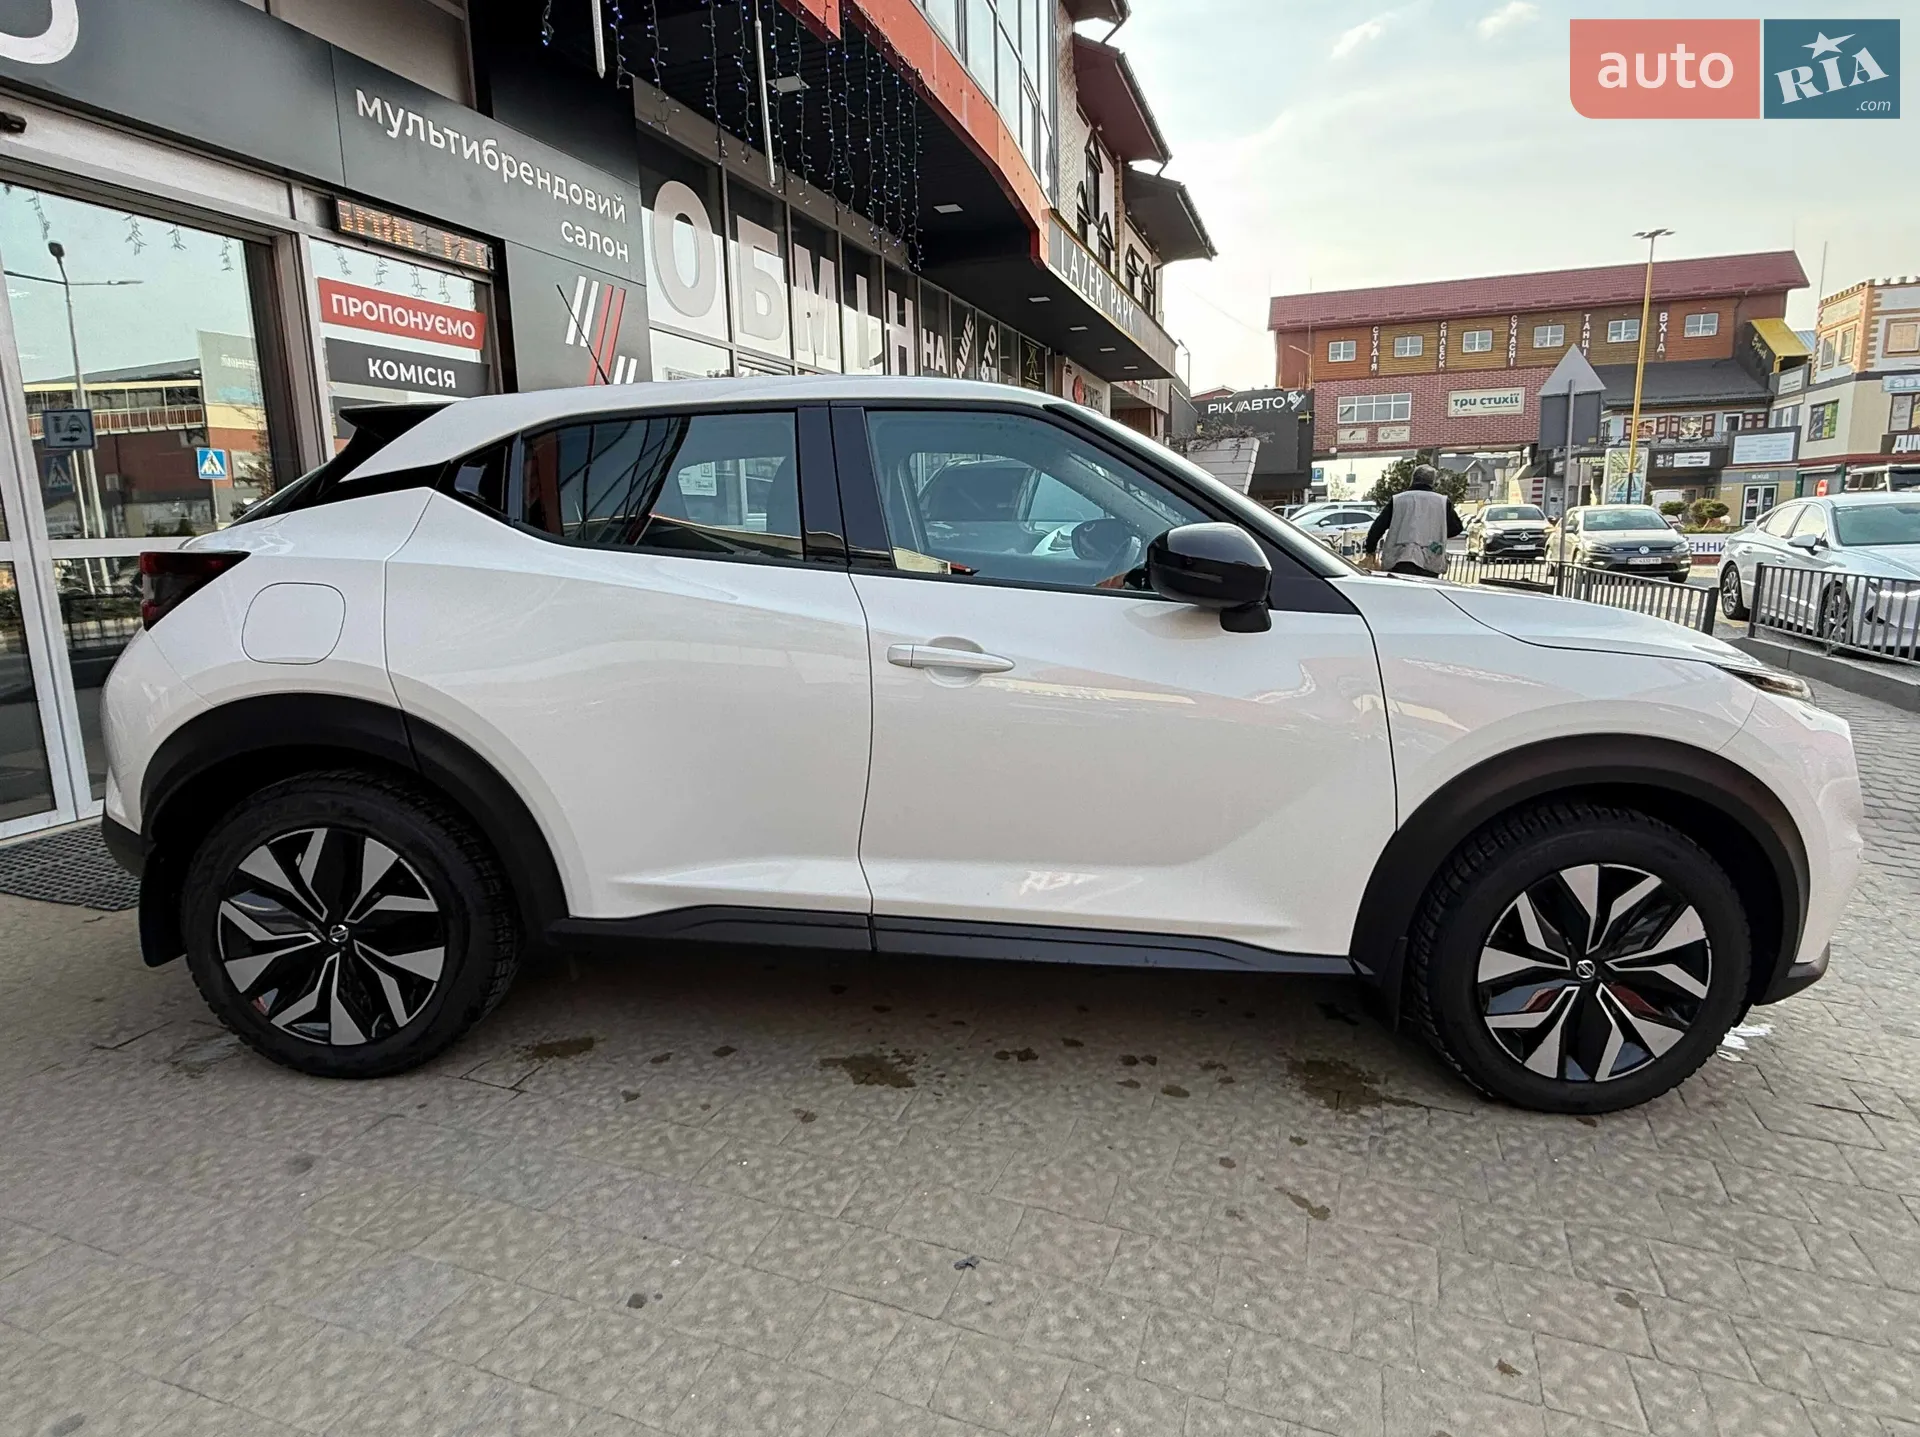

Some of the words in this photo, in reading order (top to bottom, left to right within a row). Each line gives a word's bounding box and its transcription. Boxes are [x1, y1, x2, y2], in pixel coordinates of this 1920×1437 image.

[355, 88, 627, 224] мультибрендовий
[560, 219, 630, 263] салон
[652, 179, 916, 376] ОБМІН
[922, 327, 948, 374] НА
[954, 313, 975, 379] АШЕ
[980, 324, 998, 381] ВТО
[1060, 229, 1104, 310] LAZER
[1110, 282, 1135, 335] PARK
[331, 293, 476, 340] ПРОПОНУЄМО
[1581, 313, 1592, 357] ТАНЦІ
[1656, 312, 1669, 353] ВХІД
[1370, 325, 1380, 371] СТУДІЯ
[1438, 321, 1448, 369] СПЛЕСК
[1508, 314, 1518, 367] СУЧАСНІ
[367, 356, 457, 389] КОМІСІЯ
